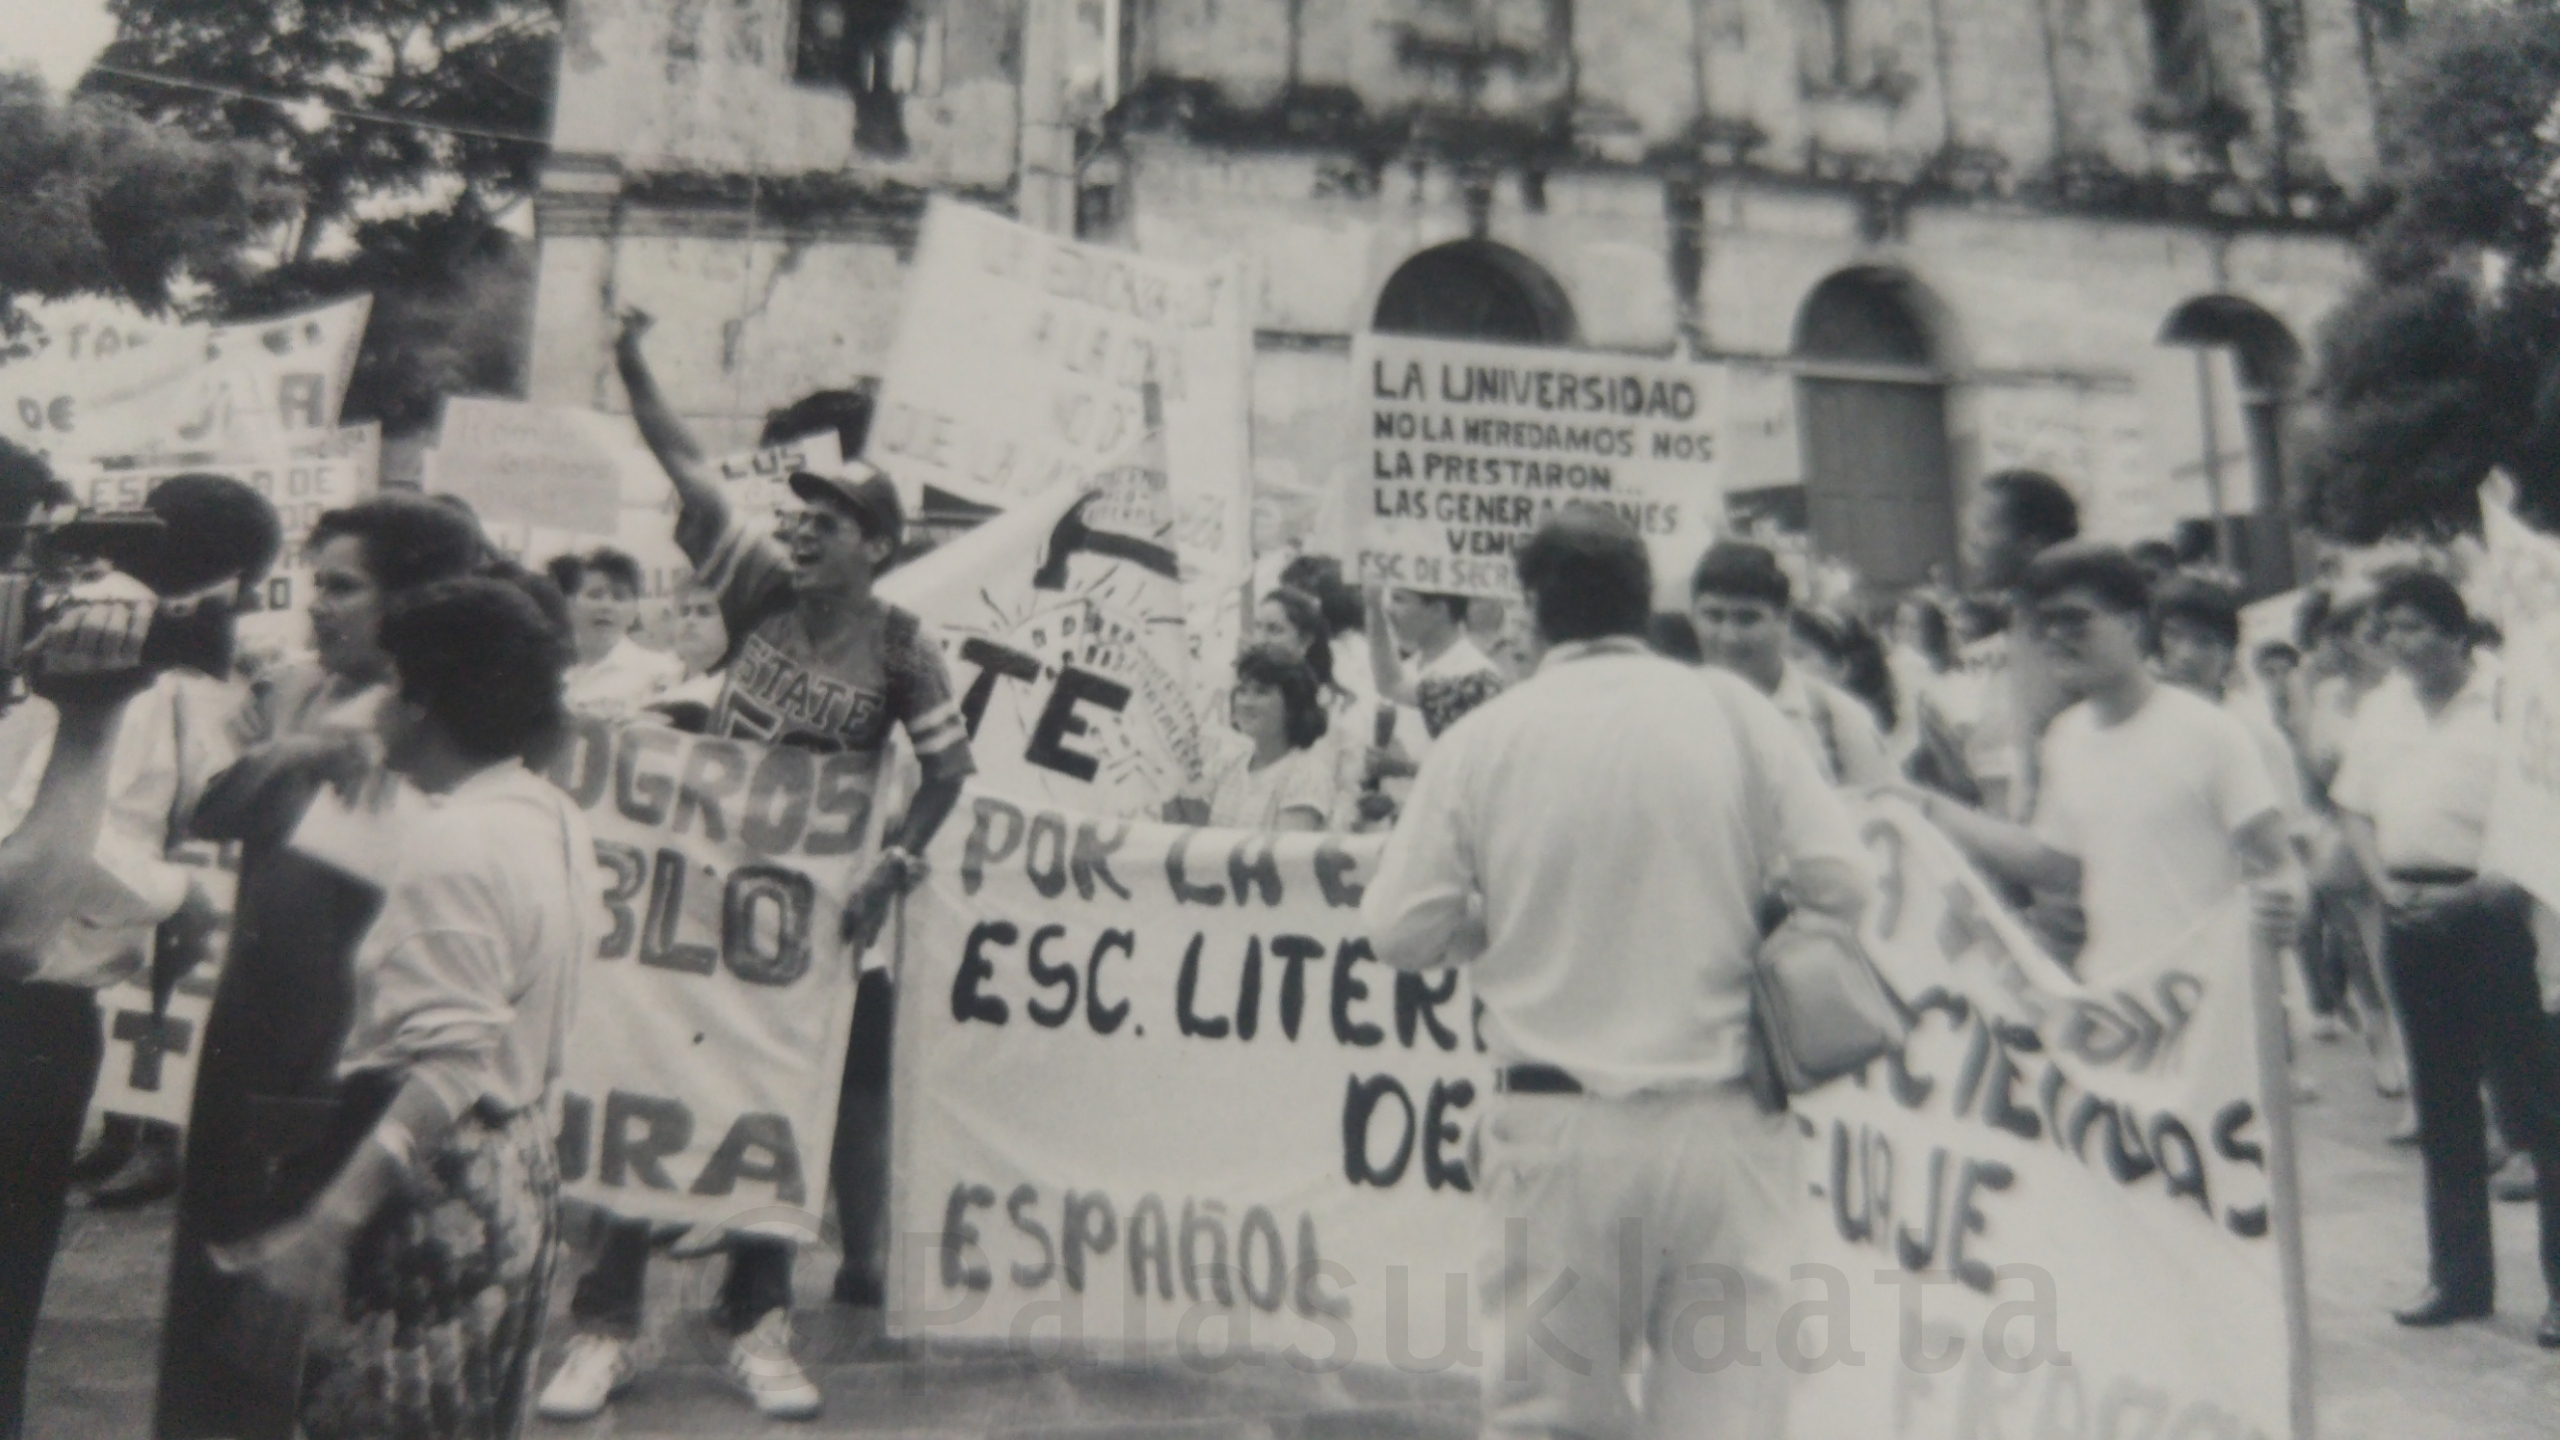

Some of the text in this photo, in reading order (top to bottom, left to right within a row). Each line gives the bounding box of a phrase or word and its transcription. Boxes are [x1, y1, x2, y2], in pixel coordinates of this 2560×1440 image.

[1373, 359, 1697, 421] LA UNIVERSIDAD
[1373, 449, 1414, 481] LA
[1651, 430, 1713, 462] NOS
[1373, 487, 1428, 520] LAS
[736, 632, 885, 737] STATE
[961, 799, 1131, 901] POR
[940, 1181, 1354, 1321] ESPAÑOL
